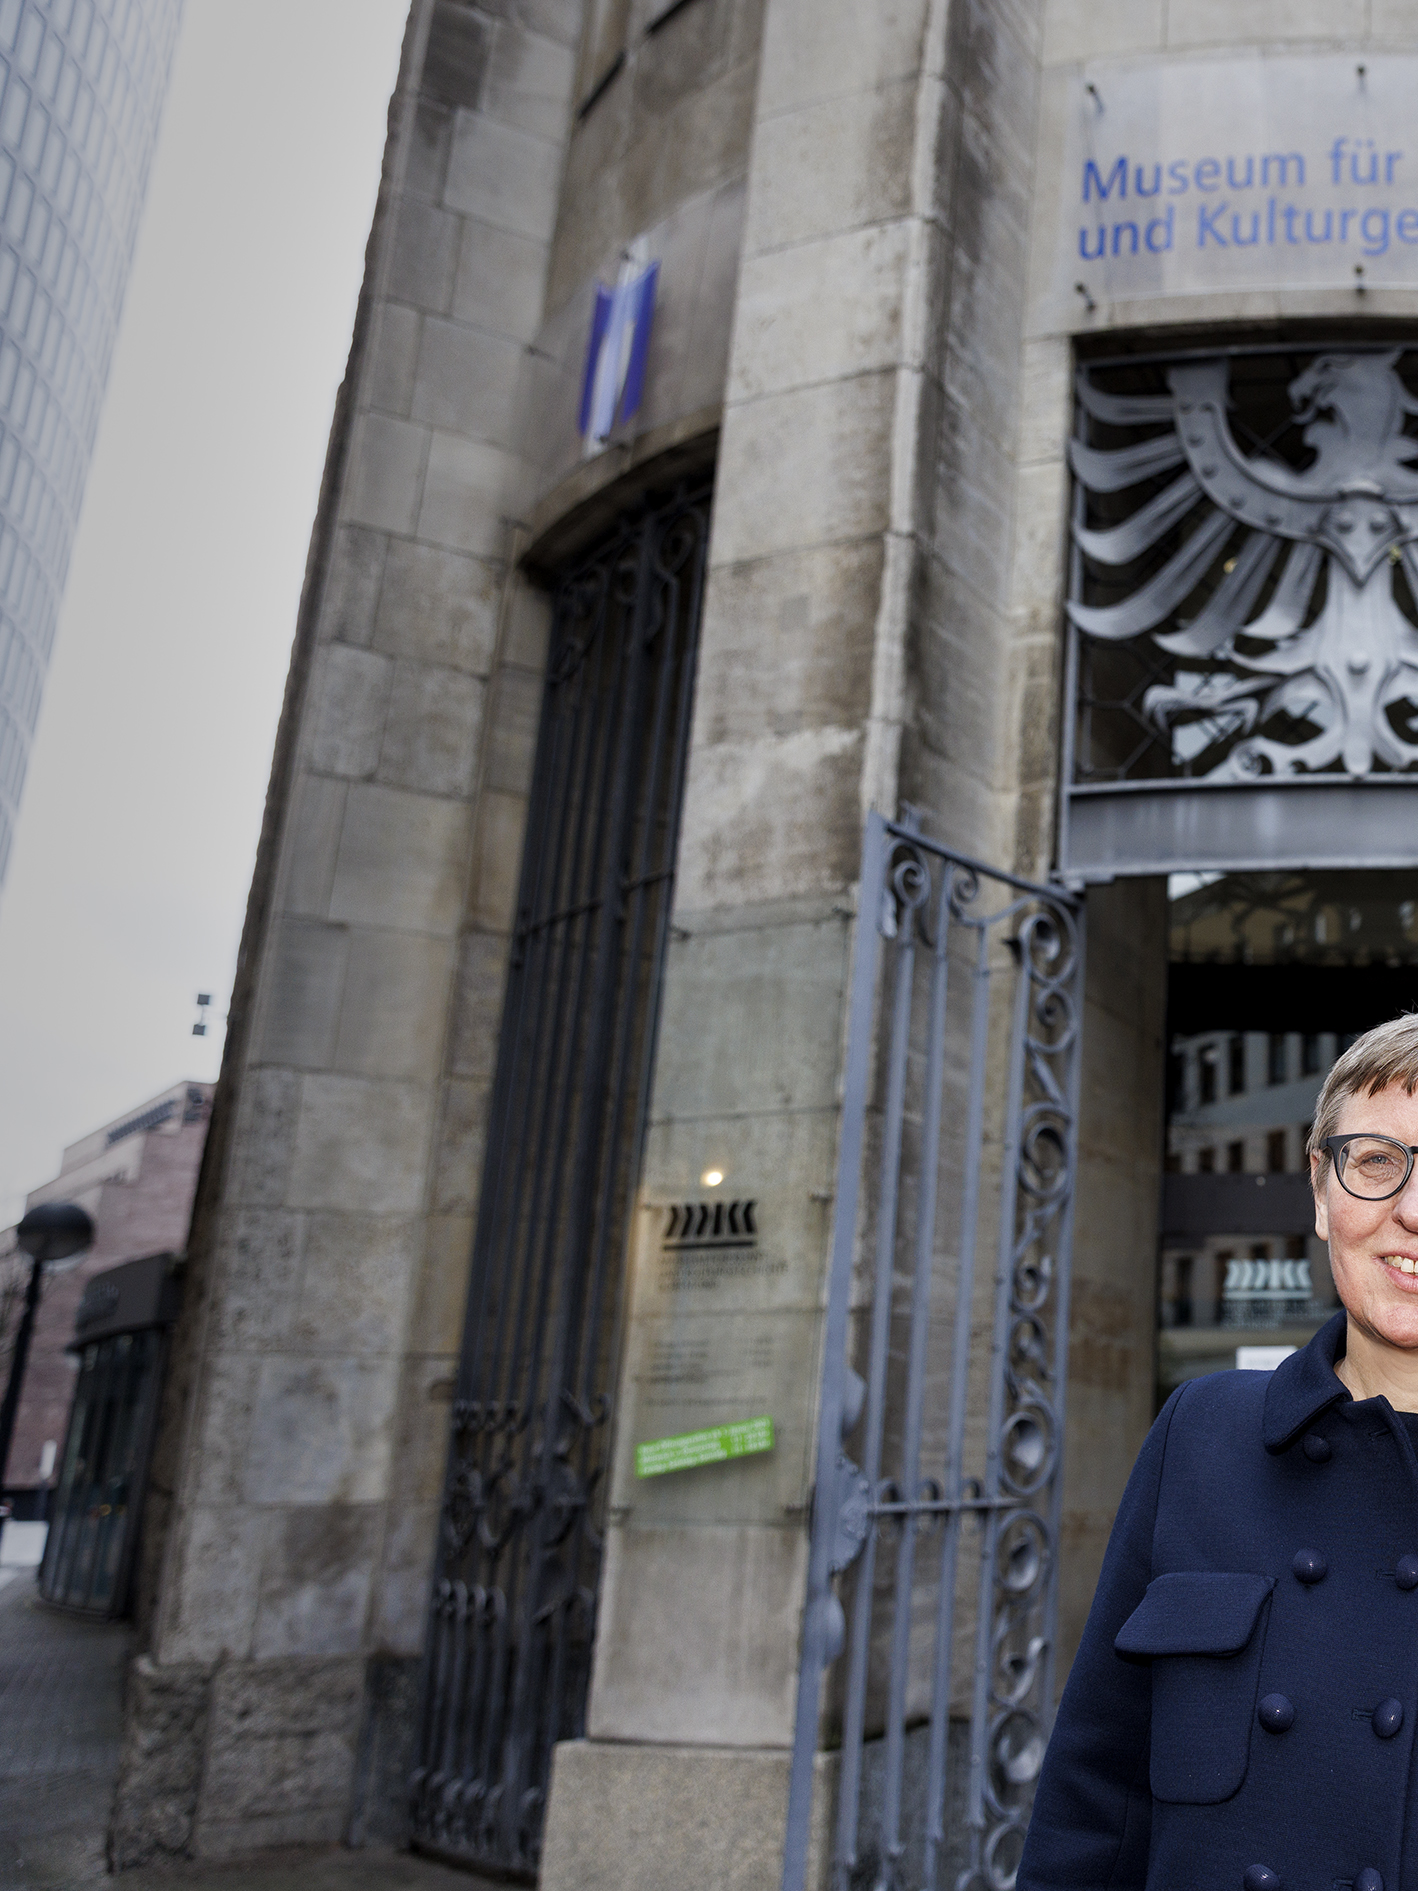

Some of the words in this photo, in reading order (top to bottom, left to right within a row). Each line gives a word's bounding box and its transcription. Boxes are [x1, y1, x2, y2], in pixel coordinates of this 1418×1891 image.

[1080, 150, 1307, 203] Museum
[1328, 135, 1403, 188] für
[1077, 205, 1175, 262] und
